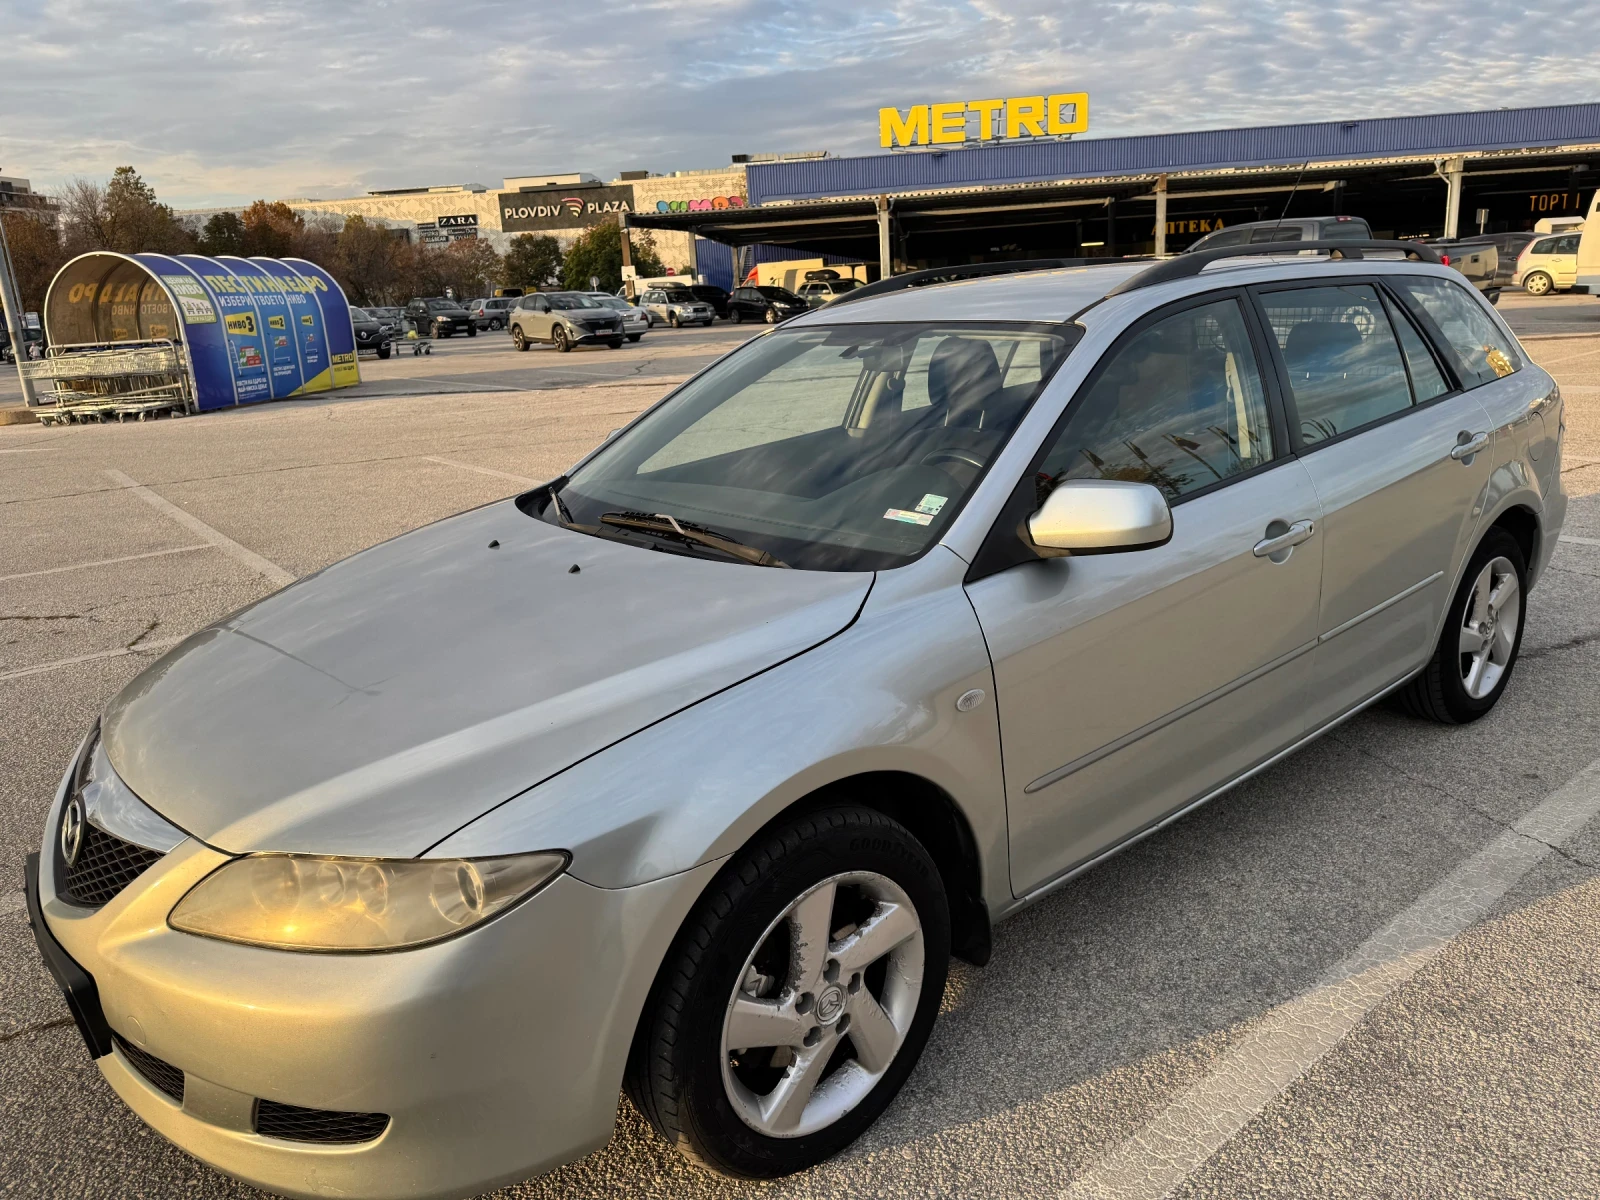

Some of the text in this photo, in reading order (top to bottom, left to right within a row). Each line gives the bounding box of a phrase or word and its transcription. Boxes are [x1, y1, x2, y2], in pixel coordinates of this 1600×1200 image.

[879, 92, 1089, 148] METRO
[504, 200, 630, 219] PLOVDIV PLAZA
[440, 216, 475, 225] ZARA
[169, 284, 204, 294] НИВО
[203, 275, 268, 293] ПЕСТИ
[218, 294, 307, 307] ИЗБЕРИ ТВОЕТО НИВО
[227, 315, 254, 332] НИВО 3
[279, 318, 285, 327] 2
[332, 354, 353, 363] METRO
